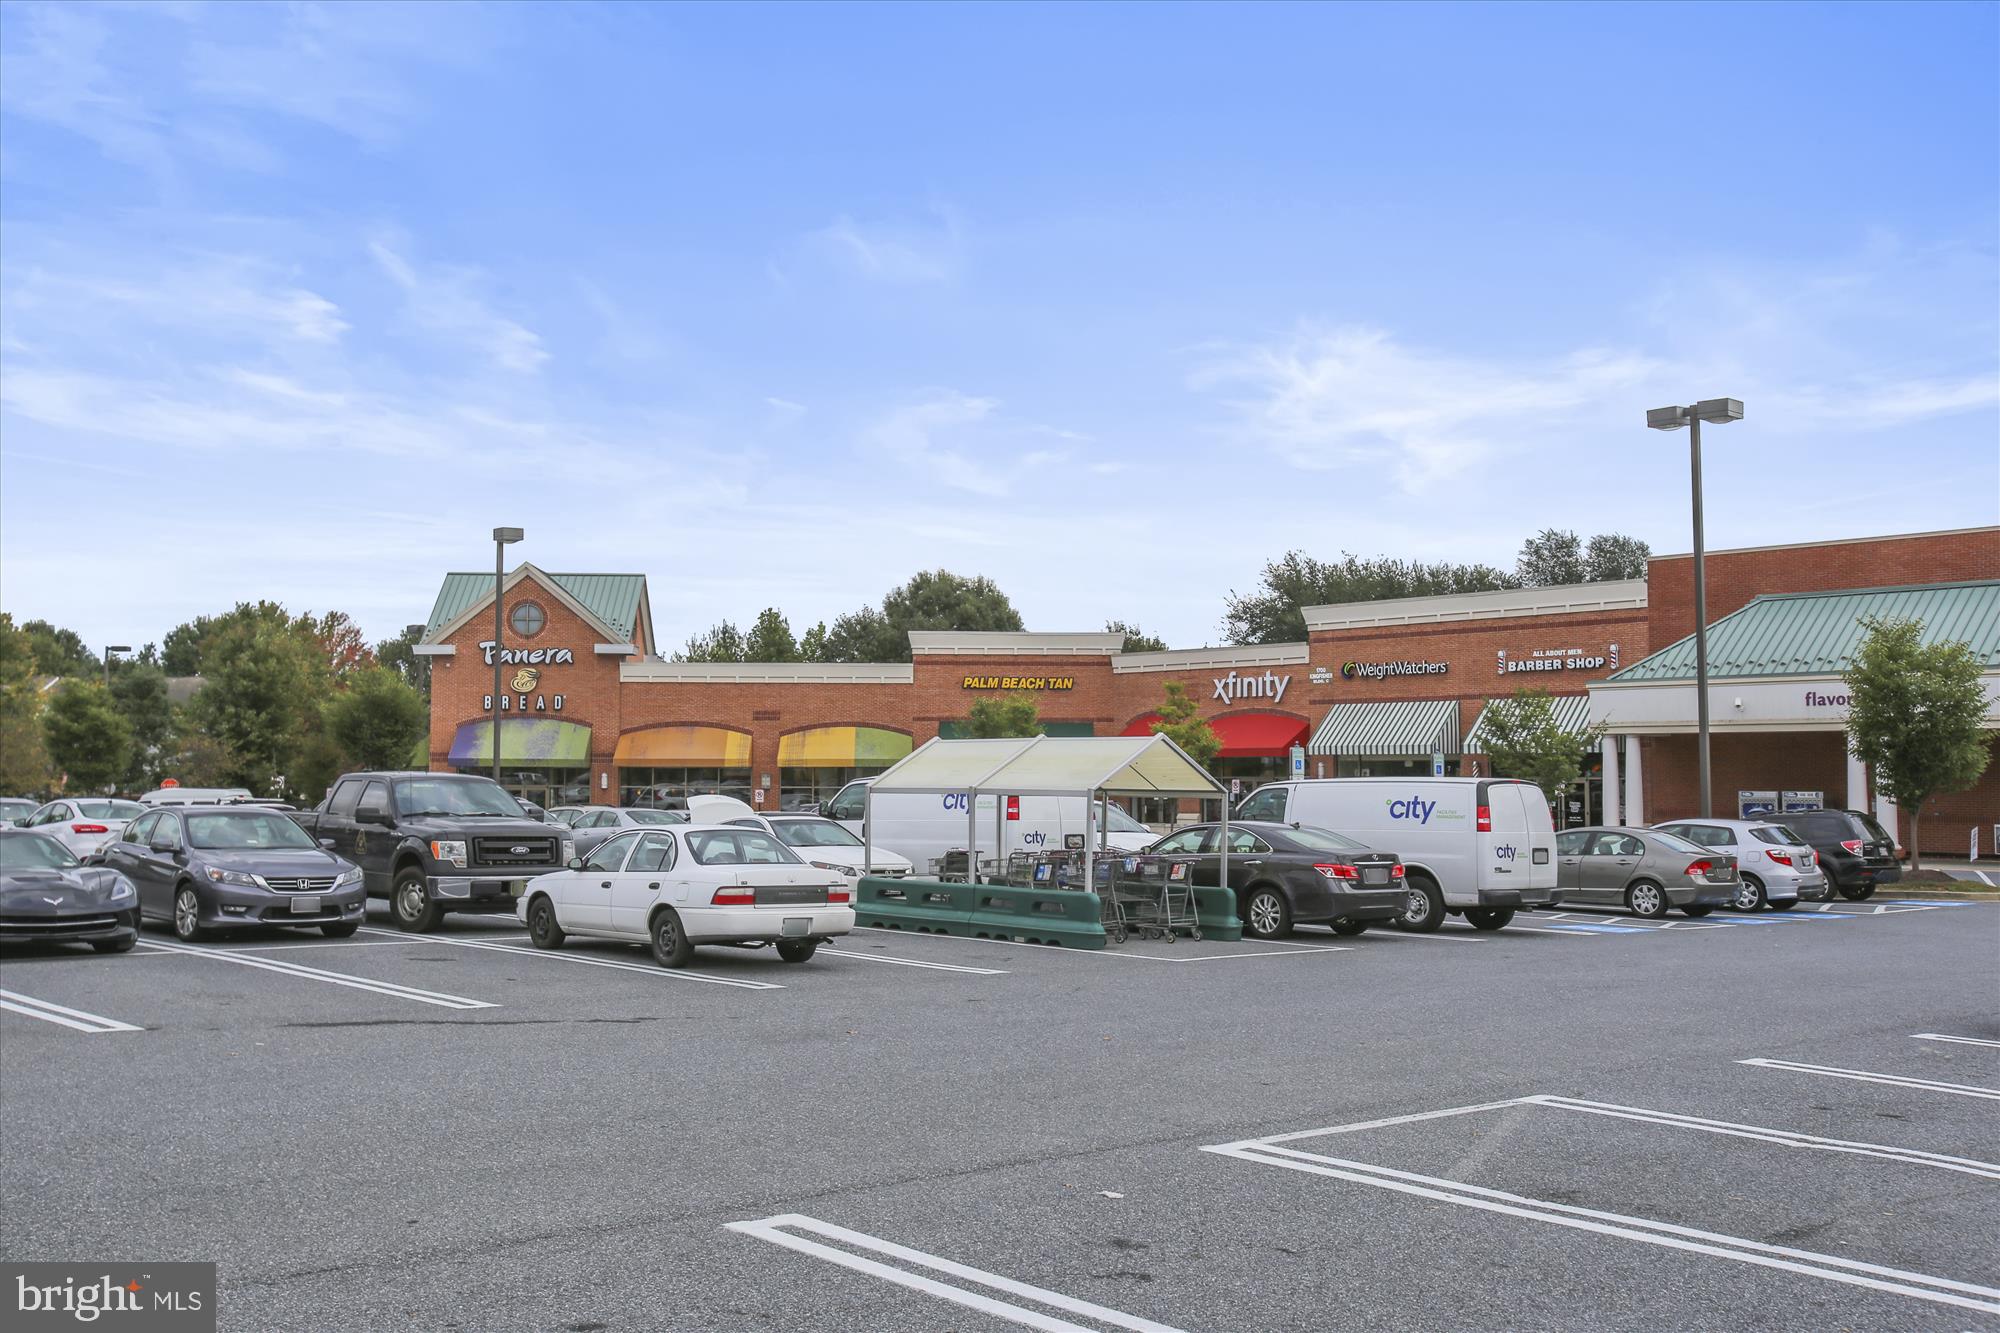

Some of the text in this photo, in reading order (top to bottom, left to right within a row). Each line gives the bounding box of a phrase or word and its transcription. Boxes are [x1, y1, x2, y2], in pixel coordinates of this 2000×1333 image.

[479, 641, 573, 665] Panera
[1355, 660, 1447, 679] WeightWatchers
[1508, 657, 1605, 672] BARBER SHOP
[963, 677, 1073, 689] PALM BEACH TAN
[1212, 669, 1290, 705] xfinity
[484, 695, 563, 710] BREAD
[1389, 795, 1436, 824] city
[1024, 830, 1046, 846] city
[1496, 843, 1517, 862] city
